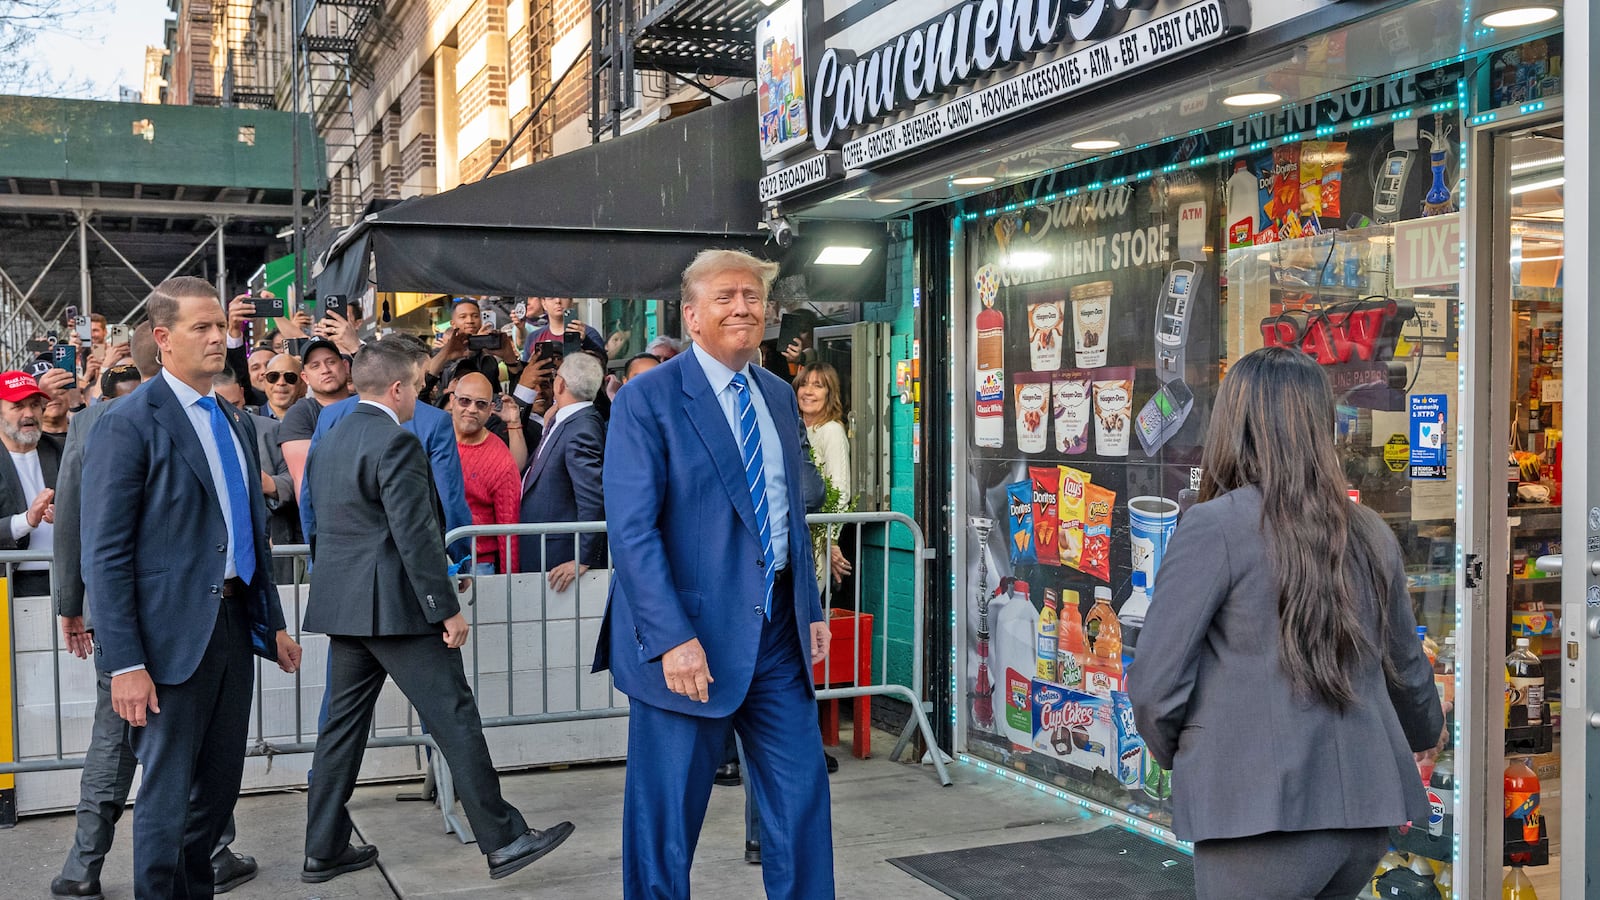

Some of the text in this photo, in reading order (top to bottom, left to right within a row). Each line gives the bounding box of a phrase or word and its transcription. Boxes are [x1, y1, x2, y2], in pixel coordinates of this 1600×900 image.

[812, 0, 1061, 151] Convenient
[842, 143, 864, 168] COFFEE
[867, 128, 897, 159] GROCERY
[901, 111, 942, 146] BEVERAGES
[946, 98, 974, 130] CANDY
[979, 80, 1021, 118] HOOKAH
[1021, 57, 1081, 103] ACCESSORIES
[1089, 45, 1113, 79] ATM
[1119, 33, 1140, 66] EBT
[1148, 16, 1184, 56] DEBIT
[1185, 3, 1220, 42] CARD
[760, 156, 826, 199] 3422 BROADWAY
[1181, 207, 1203, 221] ATM
[1111, 223, 1170, 270] STORE
[1261, 308, 1386, 366] RAW
[1353, 369, 1388, 386] PAPERS
[981, 384, 1001, 395] Wonder
[1033, 491, 1056, 505] Doritos
[1010, 503, 1032, 516] Doritos
[1038, 690, 1060, 702] Hostess
